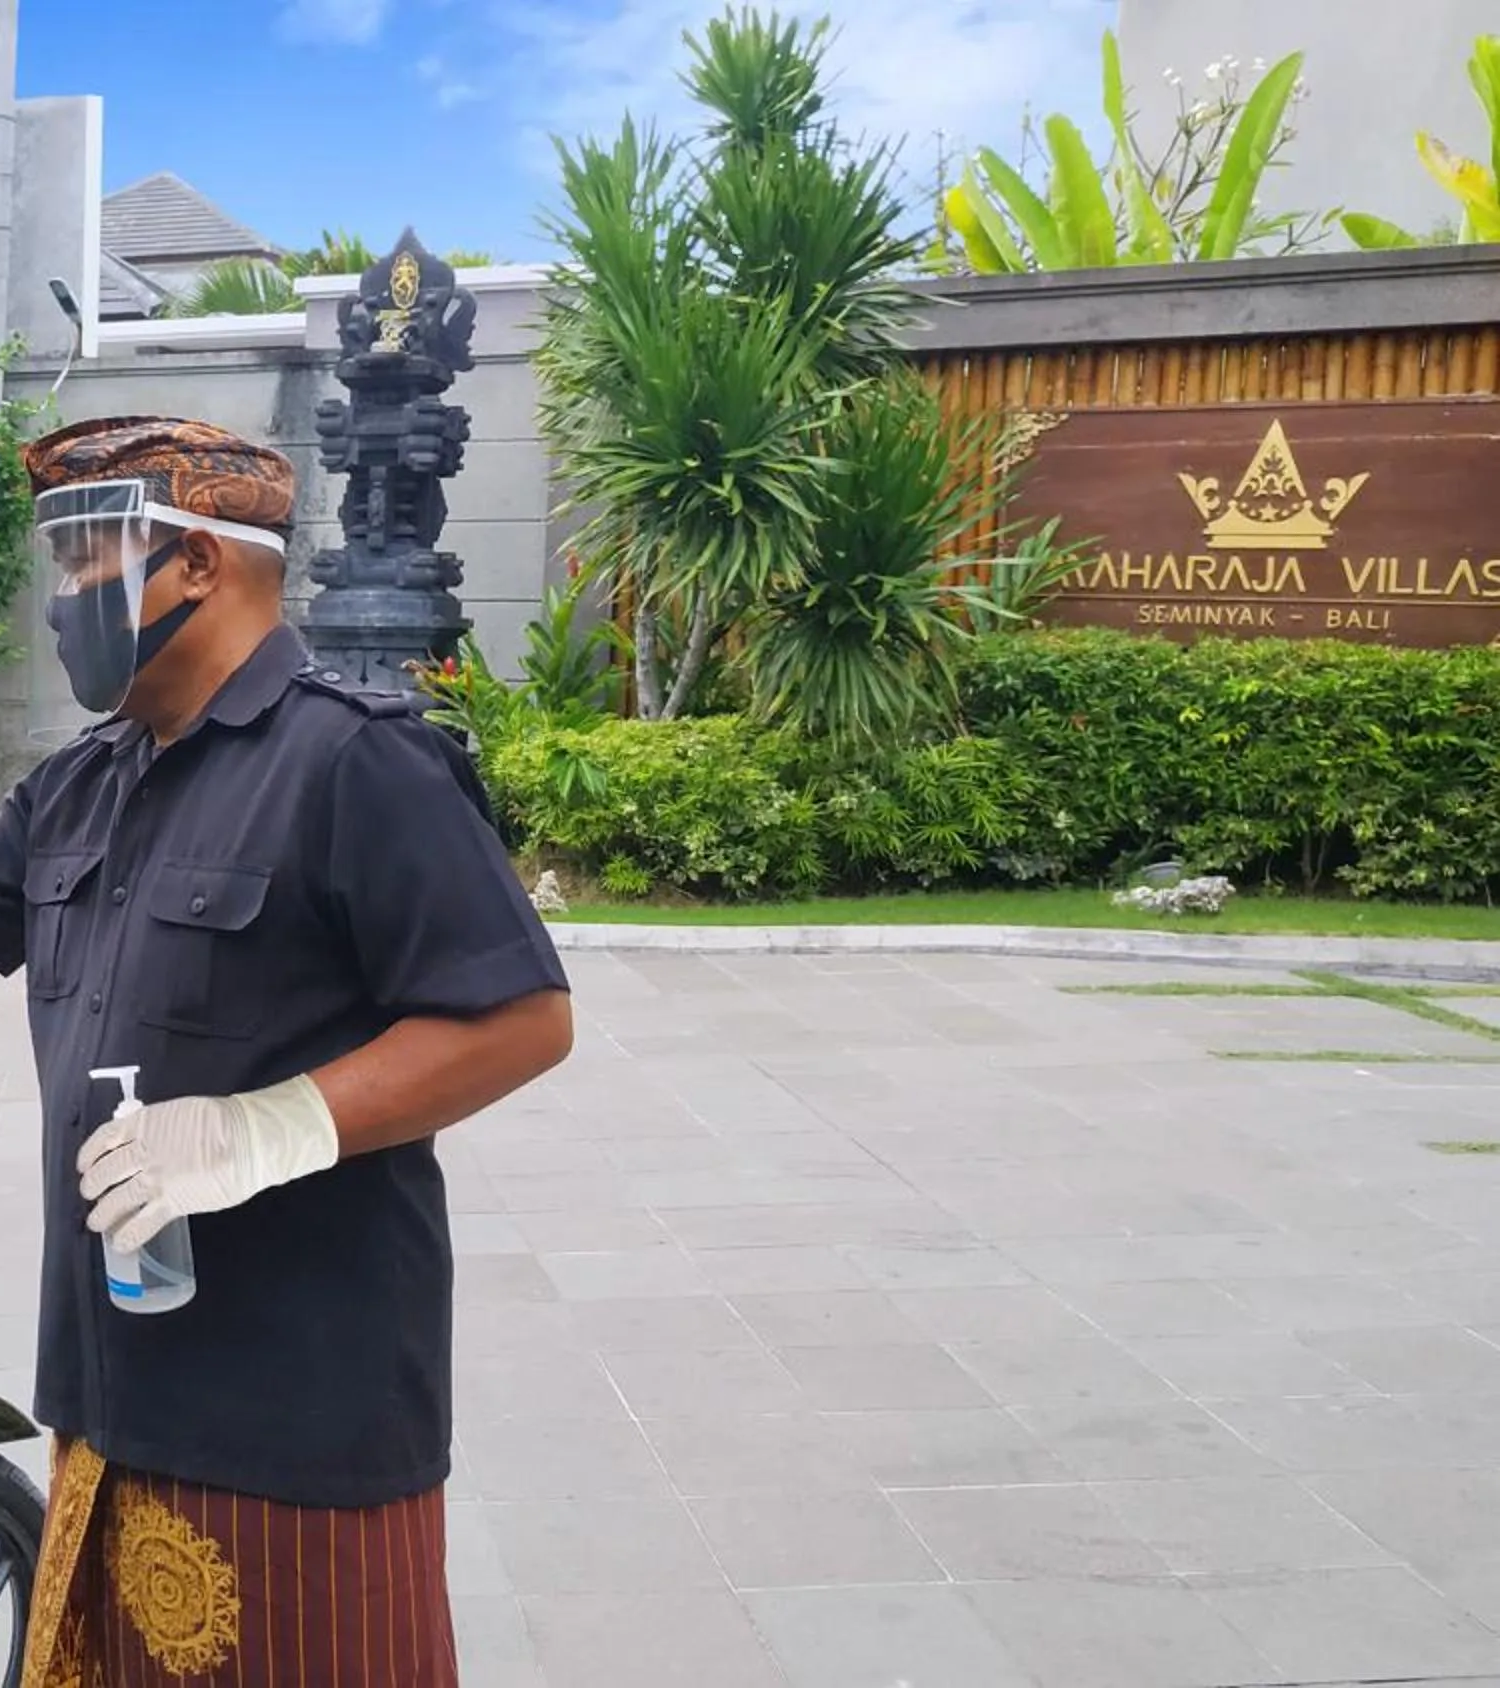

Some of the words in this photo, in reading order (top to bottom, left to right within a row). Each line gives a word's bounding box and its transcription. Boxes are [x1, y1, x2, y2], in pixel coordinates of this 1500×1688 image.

[1341, 556, 1500, 597] VILLAS
[1139, 604, 1276, 627] SEMINYAK
[1326, 608, 1390, 630] BALI
